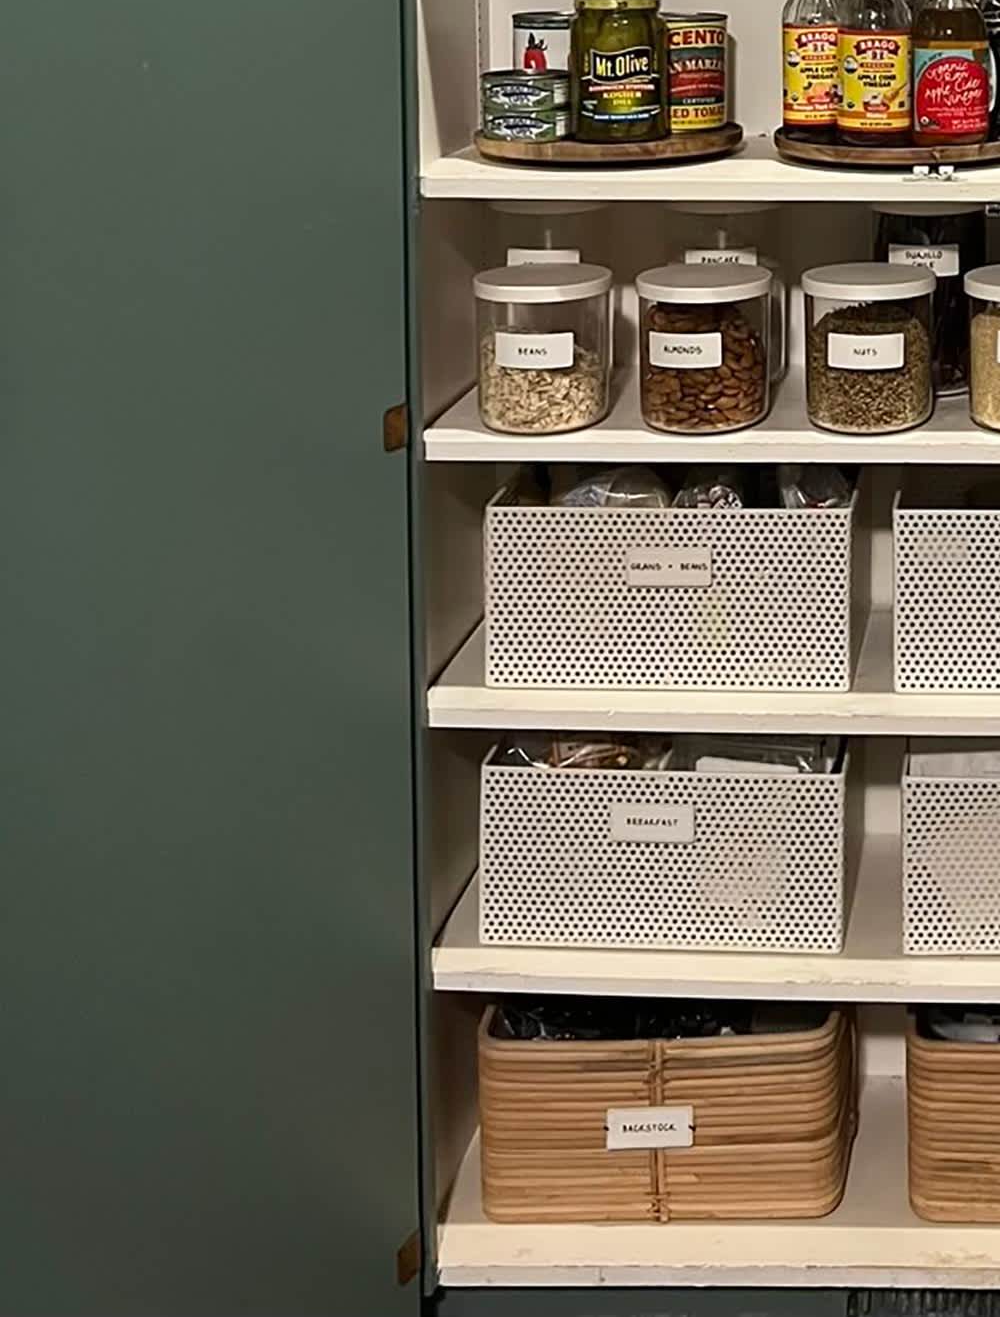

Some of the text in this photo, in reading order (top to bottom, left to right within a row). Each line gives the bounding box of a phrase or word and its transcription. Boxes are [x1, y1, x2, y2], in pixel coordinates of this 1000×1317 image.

[668, 29, 725, 46] CENTO
[595, 56, 615, 77] Mt.
[615, 54, 649, 77] Olive
[517, 348, 547, 356] BEANS
[664, 345, 703, 354] ALMONDS
[853, 347, 878, 357] NUTS
[680, 562, 708, 571] BEANS
[626, 817, 679, 826] BREAKFAST
[622, 1123, 677, 1133] BACKSTOCK
